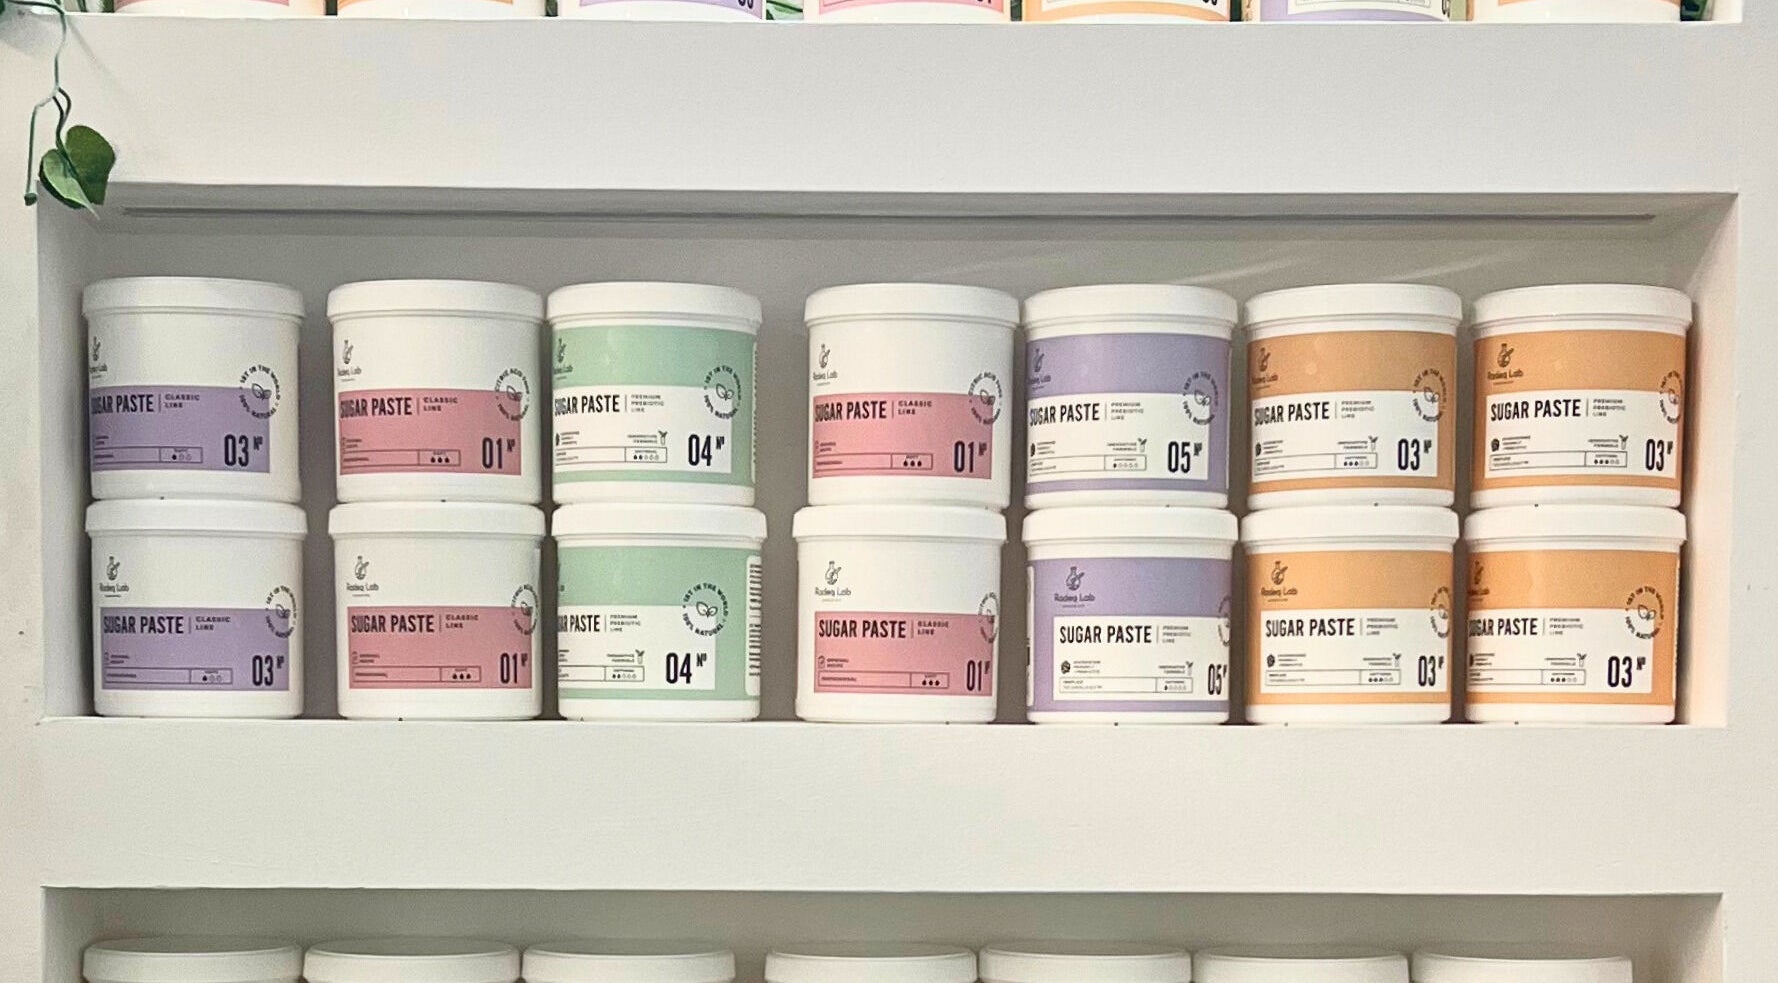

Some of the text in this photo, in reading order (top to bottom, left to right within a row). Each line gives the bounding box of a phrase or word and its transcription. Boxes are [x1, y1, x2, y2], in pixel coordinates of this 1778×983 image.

[1508, 368, 1524, 378] Lab
[116, 394, 153, 414] PASTE
[340, 397, 412, 419] SUGAR PASTE
[581, 395, 620, 415] PASTE
[815, 401, 887, 423] SUGAR PASTE
[898, 400, 932, 408] CLASSIC
[1254, 401, 1330, 427] SUGAR PASTE
[1490, 399, 1581, 422] SUGAR PASTE
[1029, 404, 1100, 428] SUGAR PASTE
[224, 434, 249, 467] 03
[482, 437, 503, 469] 01
[688, 433, 712, 467] 04
[954, 441, 975, 474] 01
[1167, 441, 1191, 474] 05
[1397, 438, 1421, 471] 03
[1645, 438, 1665, 472] 03
[694, 583, 702, 592] IN
[703, 582, 716, 592] THE
[717, 588, 729, 617] WORLD
[837, 586, 852, 596] Lab
[1079, 592, 1095, 602] Lab
[1283, 587, 1298, 596] Lab
[104, 615, 184, 635] SUGAR PASTE
[196, 615, 231, 623] CLASSIC
[352, 614, 435, 634] SUGAR PASTE
[446, 614, 480, 622] CLASSIC
[570, 614, 601, 633] PASTE
[818, 619, 907, 639] SUGAR PASTE
[1265, 618, 1355, 638] SUGAR PASTE
[1497, 617, 1538, 636] PASTE
[695, 623, 725, 637] NATURAL
[1059, 625, 1152, 645] SUGAR PASTE
[252, 654, 274, 687] 03
[500, 652, 520, 685] 01
[667, 652, 693, 685] 04
[966, 659, 984, 692] 01
[1207, 662, 1222, 697] 05
[1418, 655, 1436, 688] 03
[1607, 655, 1632, 688] 03
